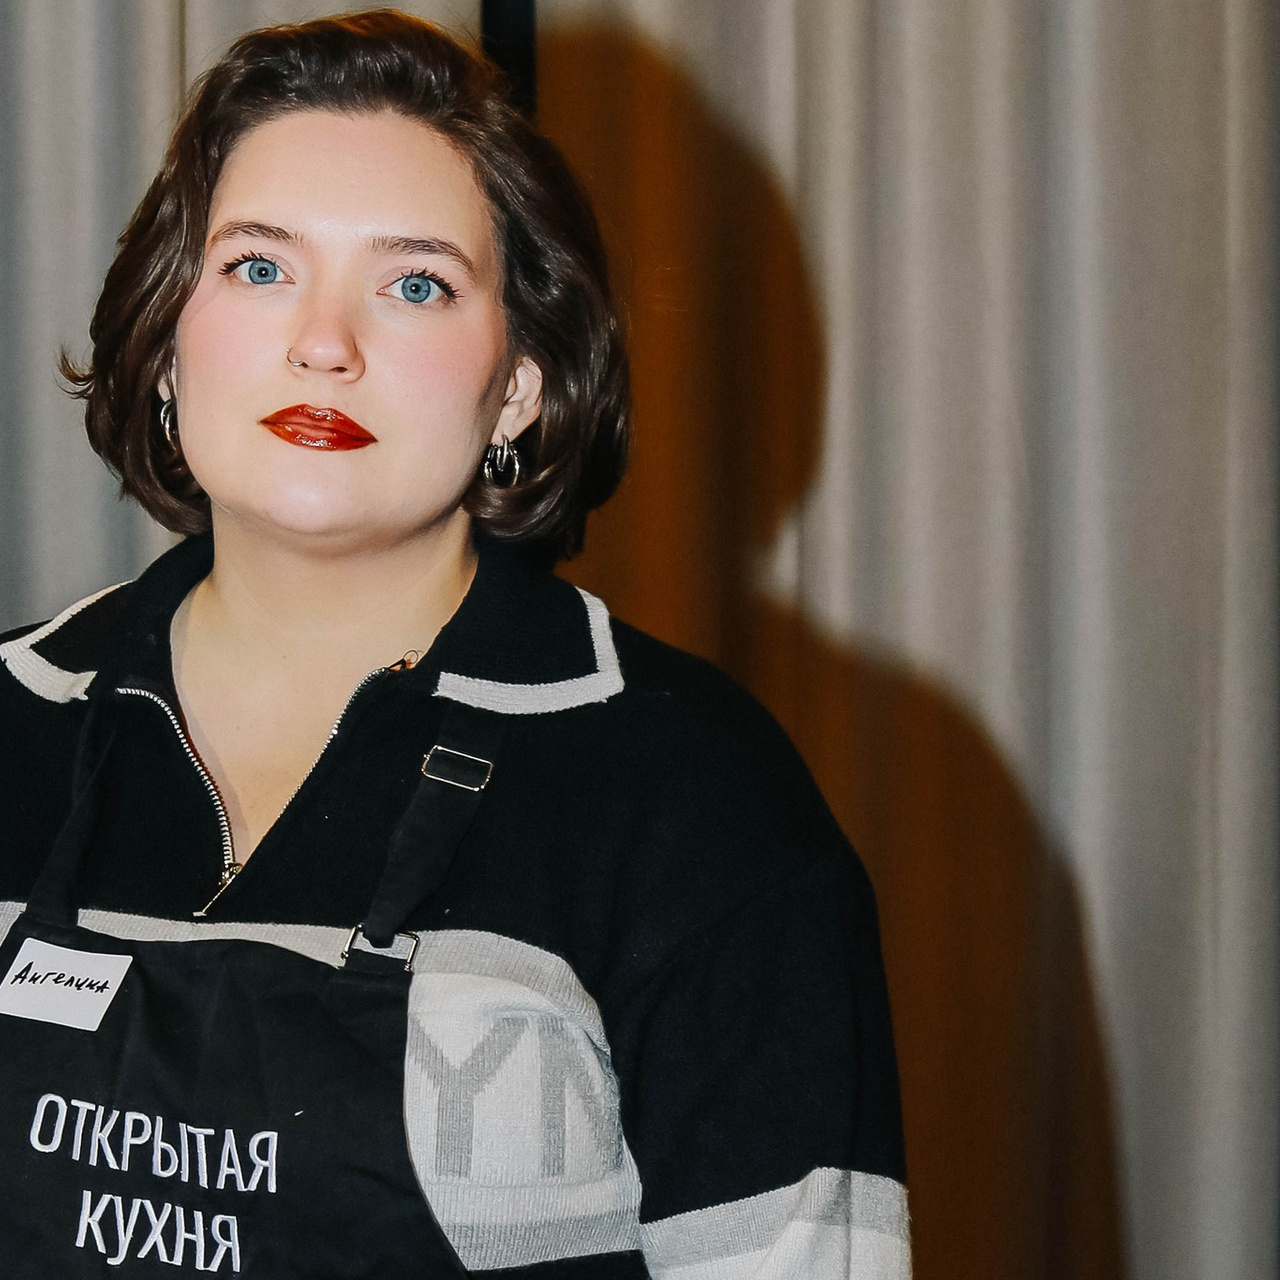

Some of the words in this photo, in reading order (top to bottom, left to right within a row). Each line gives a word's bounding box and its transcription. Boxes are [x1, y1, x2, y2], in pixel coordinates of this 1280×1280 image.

[10, 961, 110, 994] Ангелина
[29, 1093, 279, 1193] ОТКРЫТАЯ
[75, 1190, 241, 1272] КУХНЯ
